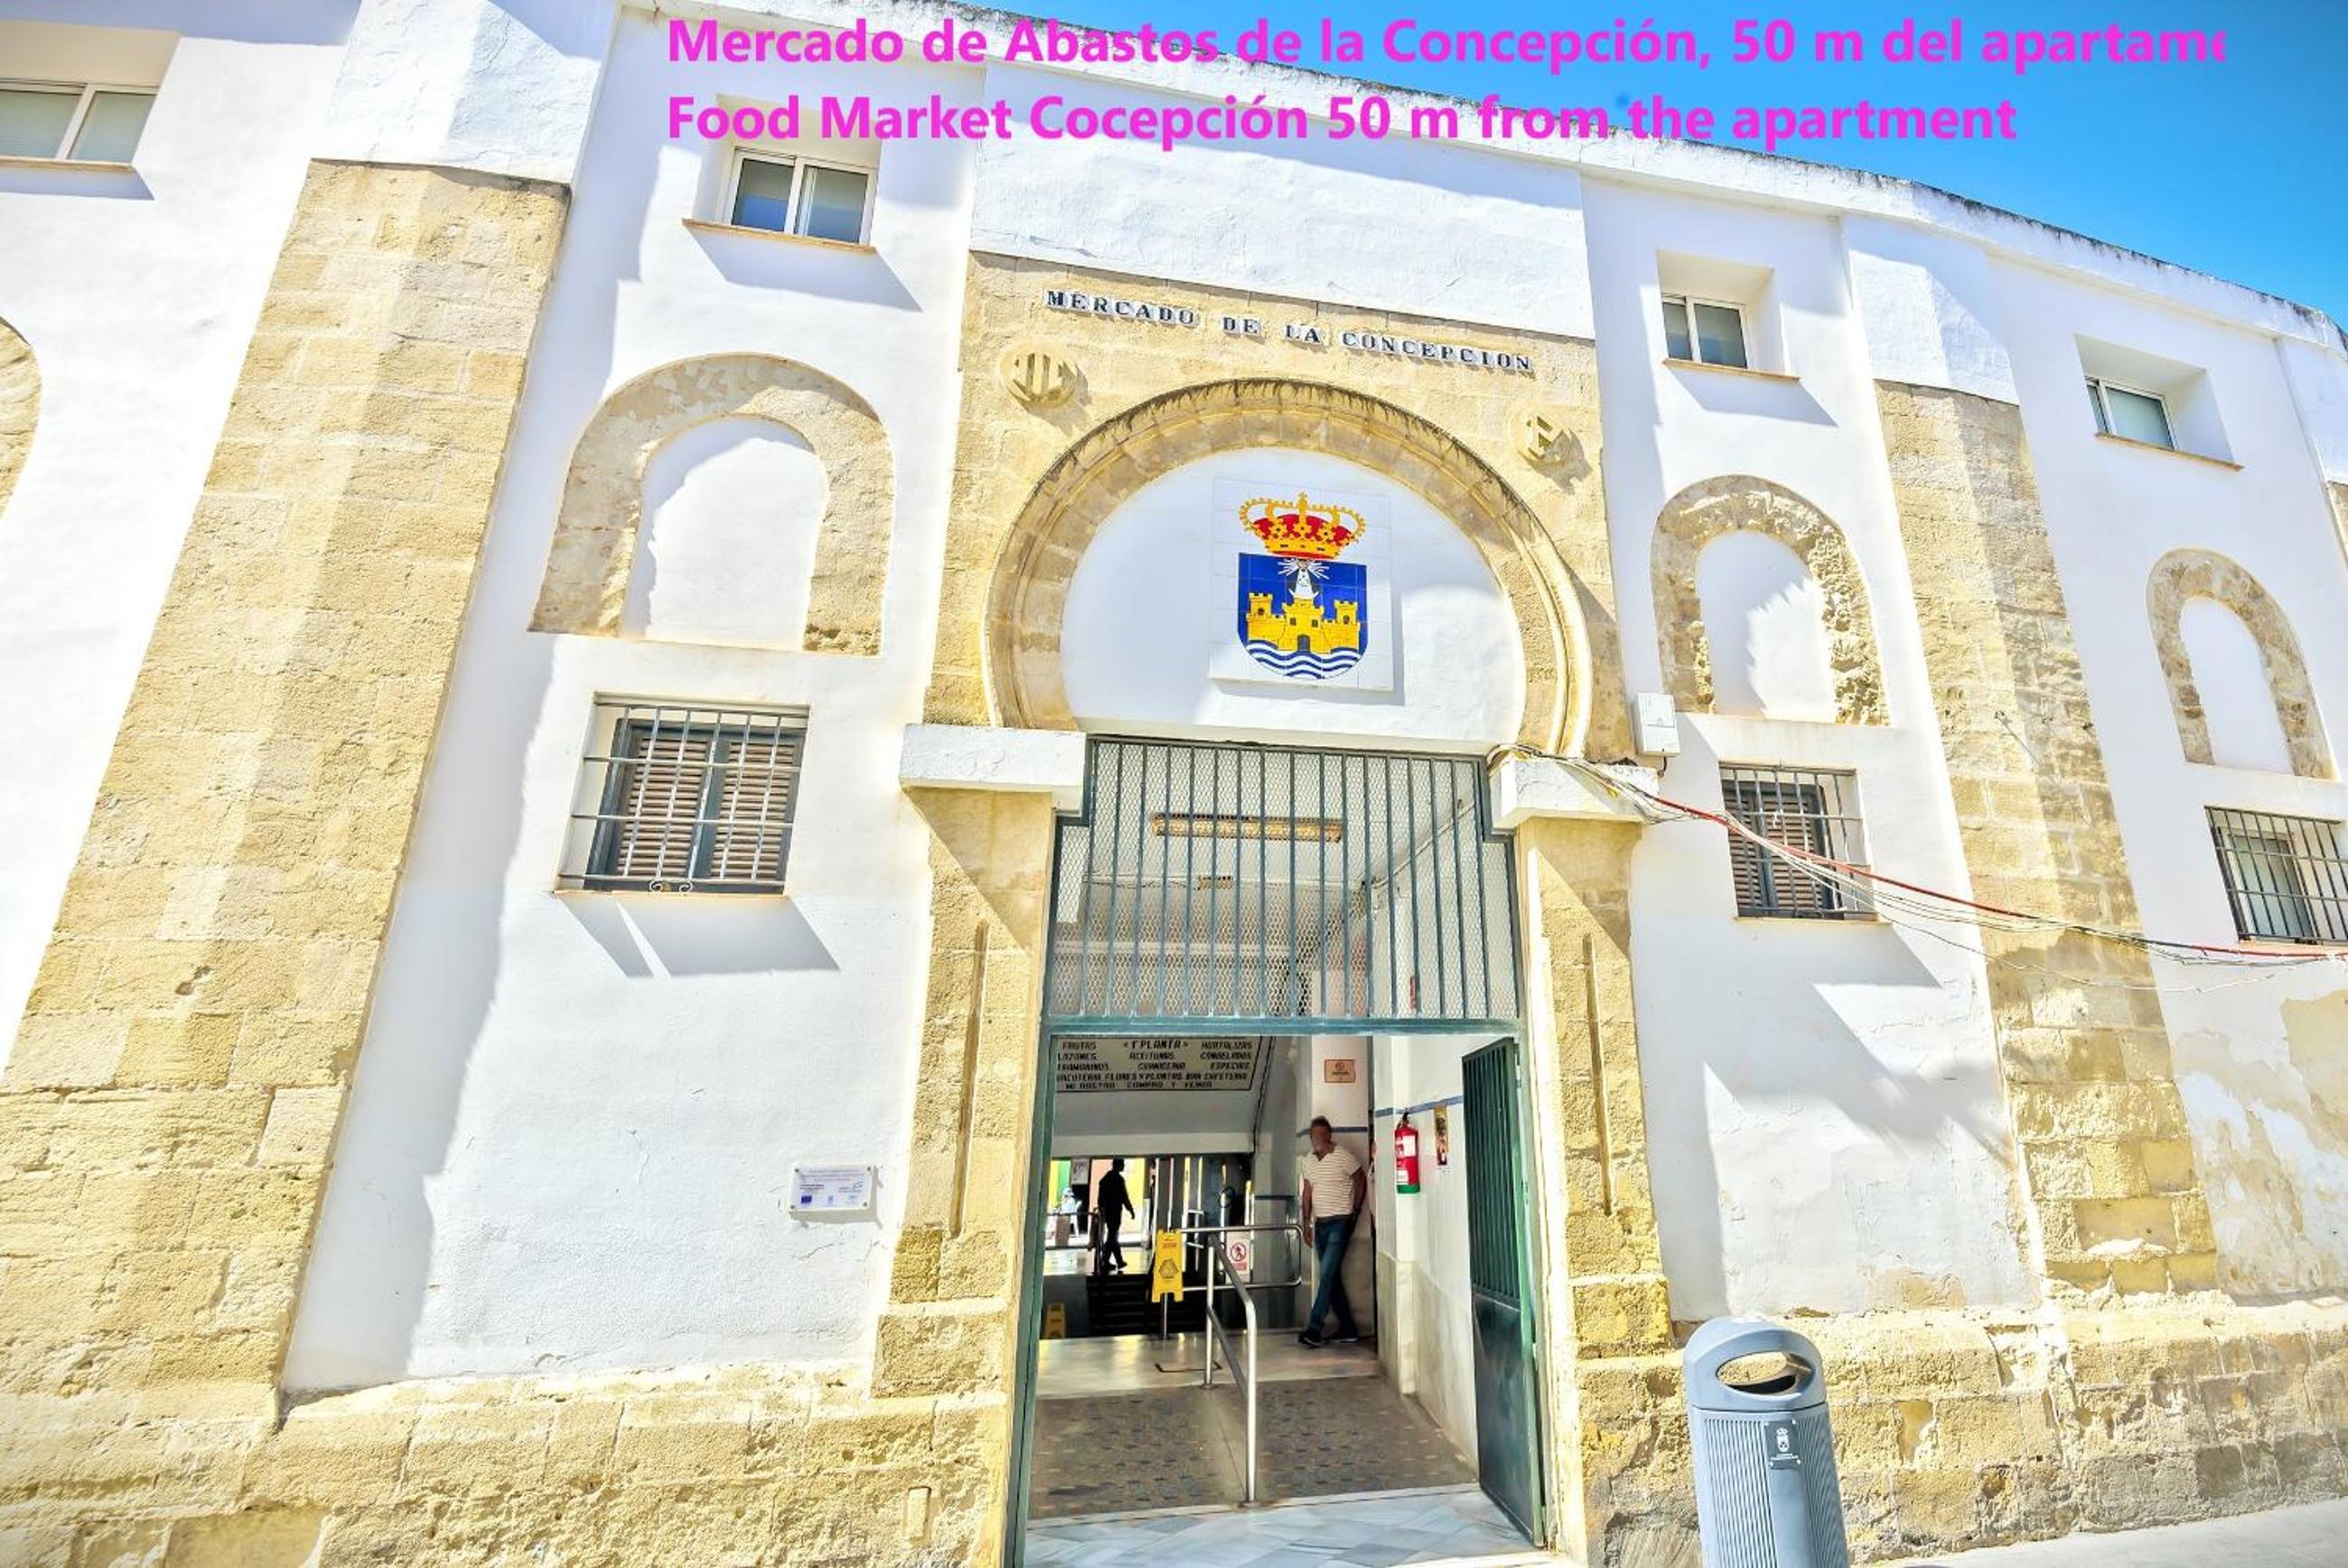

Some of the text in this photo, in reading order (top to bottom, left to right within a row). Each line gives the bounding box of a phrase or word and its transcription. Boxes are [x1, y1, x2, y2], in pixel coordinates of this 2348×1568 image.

[1047, 290, 1529, 370] MERCADO DE LA CONCEPCION
